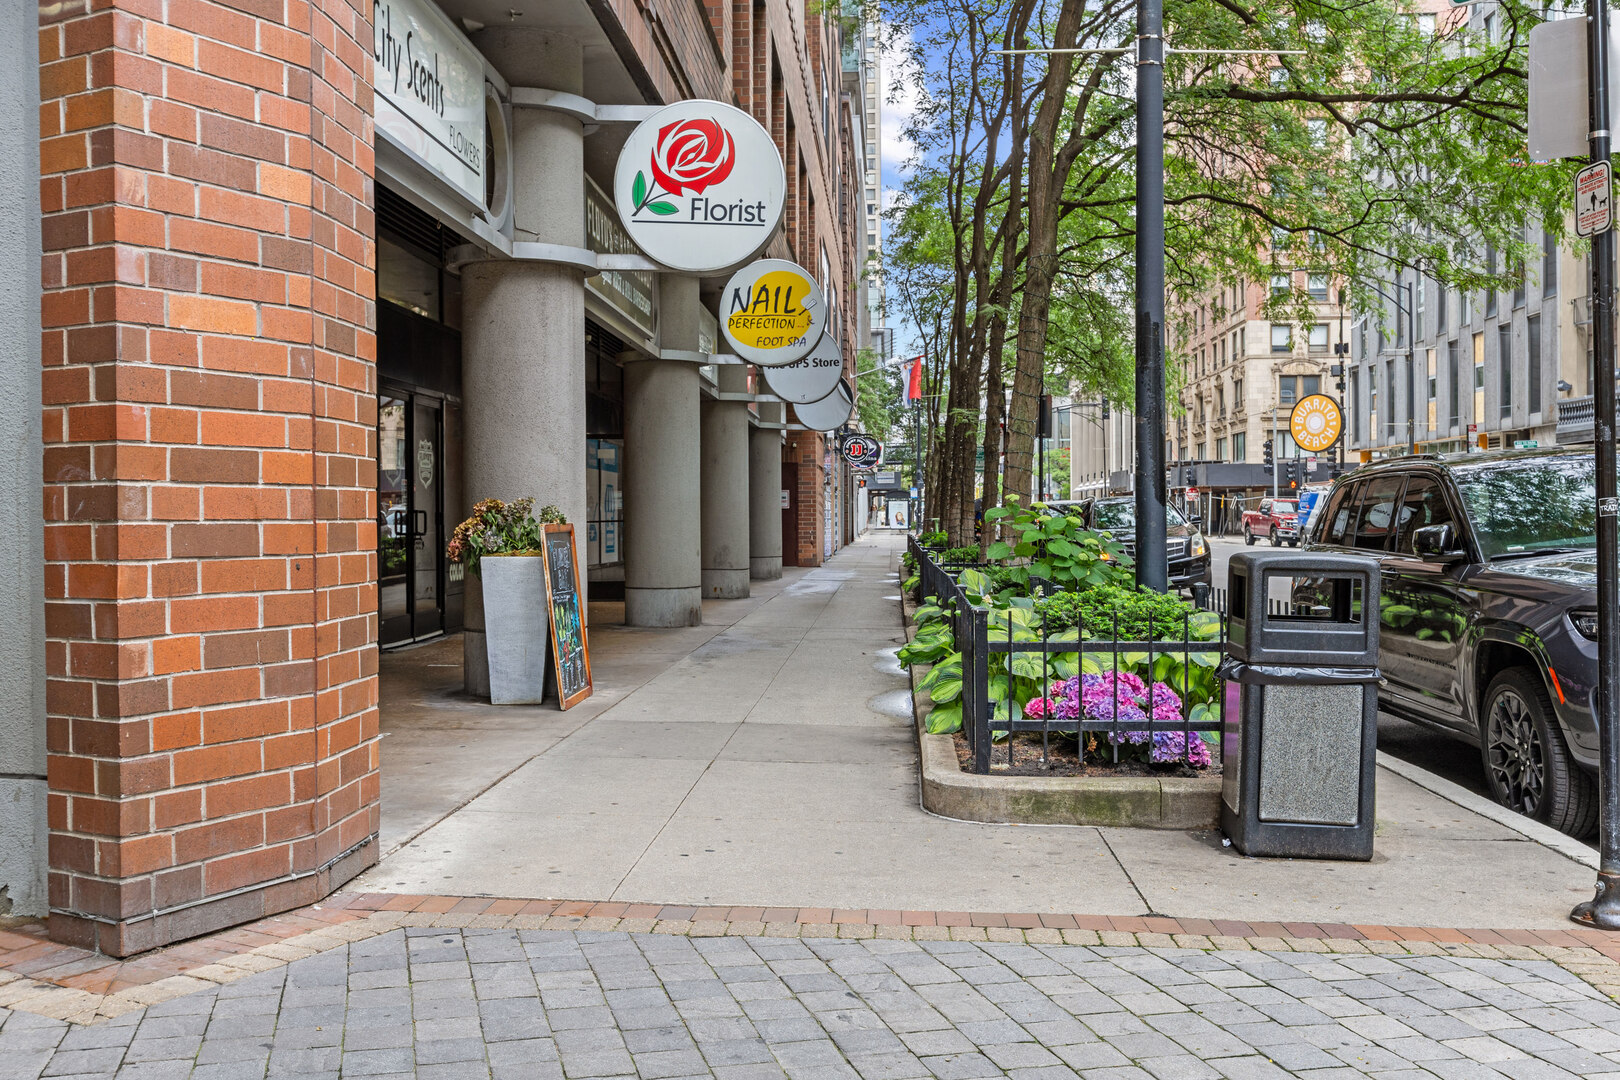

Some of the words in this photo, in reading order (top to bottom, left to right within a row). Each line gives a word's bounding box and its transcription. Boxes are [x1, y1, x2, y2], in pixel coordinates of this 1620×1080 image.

[373, 0, 401, 94] City
[407, 31, 444, 118] Scents
[449, 124, 480, 168] FLOWERS
[1580, 169, 1605, 183] WARNING!
[691, 198, 766, 223] Florist
[730, 284, 796, 315] NAIL
[756, 336, 784, 347] FOOT
[787, 336, 807, 347] SPA
[812, 357, 840, 368] Store
[1294, 398, 1337, 424] BURRITO
[850, 442, 863, 455] JJ
[1297, 427, 1336, 448] BEACH
